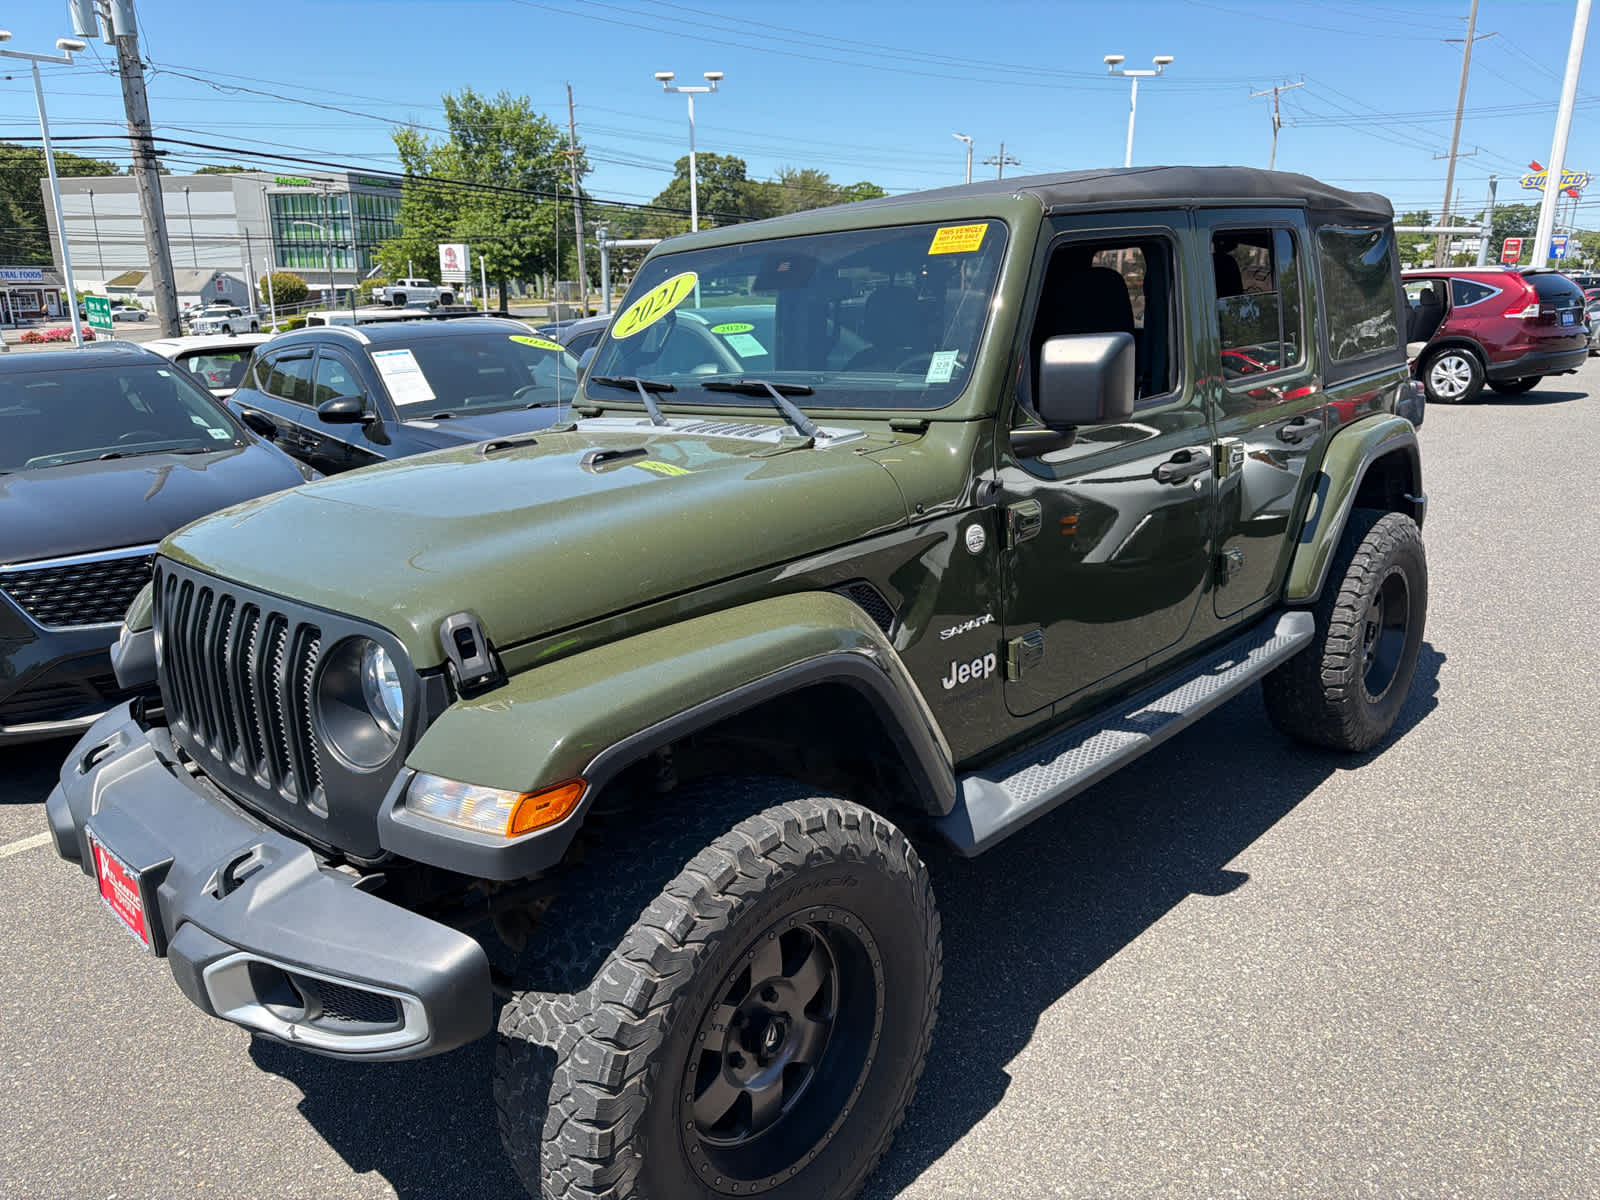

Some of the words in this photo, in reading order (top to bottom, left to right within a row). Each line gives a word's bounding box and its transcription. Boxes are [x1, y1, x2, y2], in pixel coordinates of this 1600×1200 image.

[1525, 174, 1584, 186] SUCO
[19, 271, 41, 279] FOODS
[624, 280, 681, 333] 2021
[939, 613, 995, 640] SAHARA
[942, 652, 997, 690] Jeep
[113, 887, 138, 920] TOYOTA
